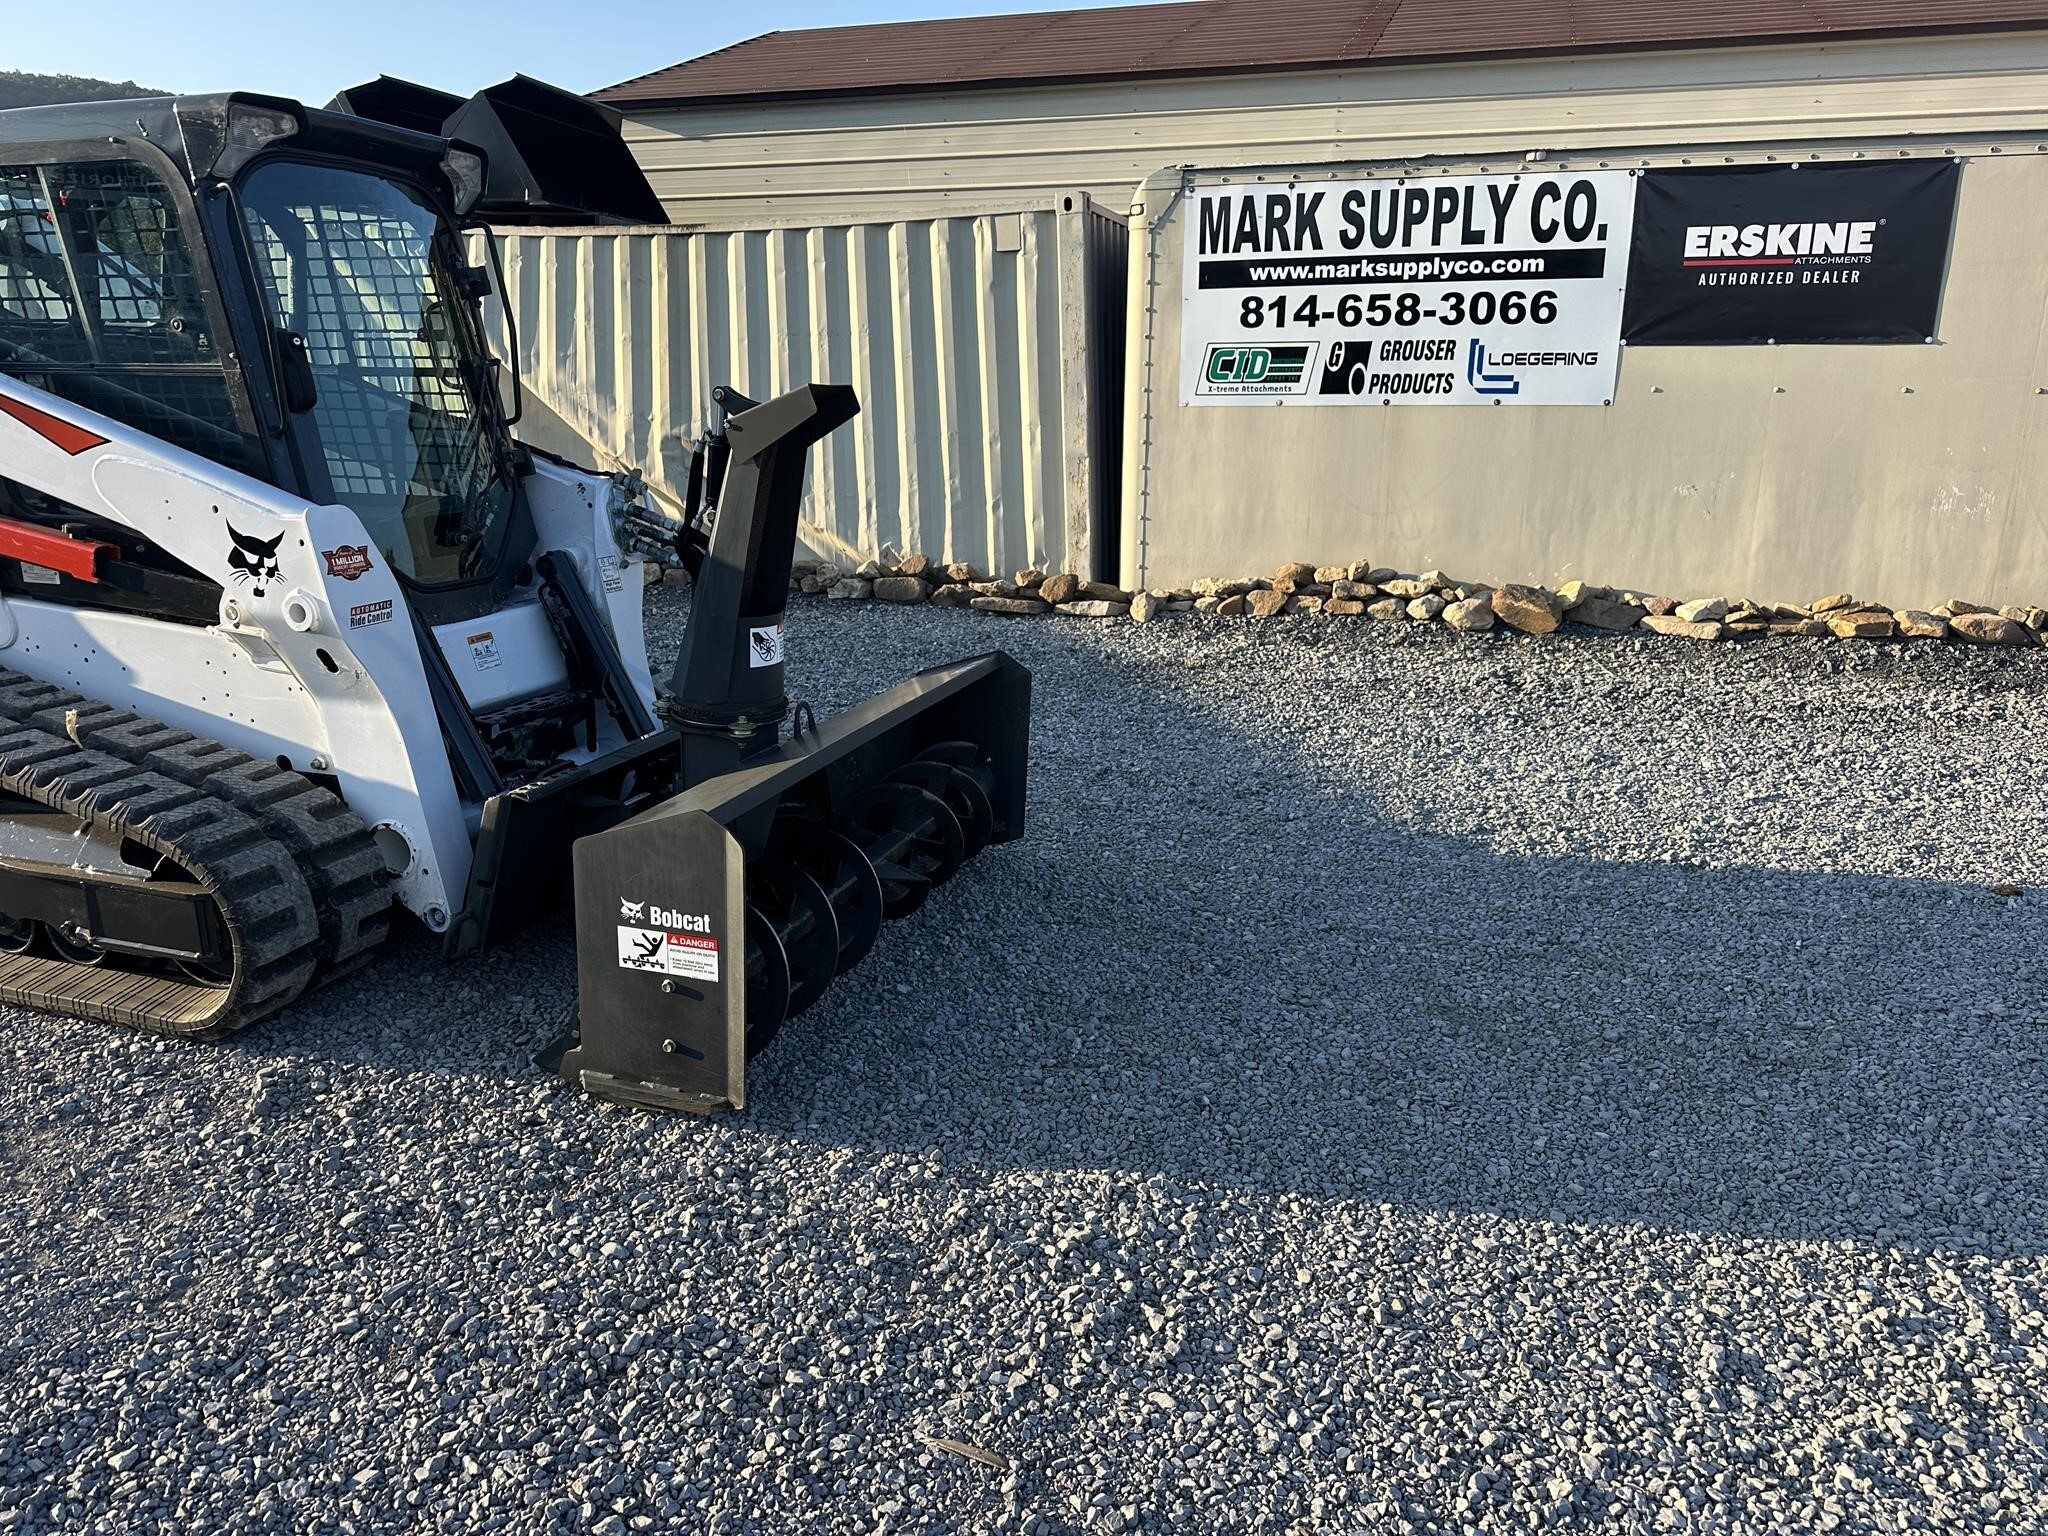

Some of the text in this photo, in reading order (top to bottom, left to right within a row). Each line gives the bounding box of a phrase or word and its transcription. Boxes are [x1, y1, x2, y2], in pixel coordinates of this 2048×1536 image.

[1199, 180, 1608, 255] MARK SUPPLY CO.
[1683, 222, 1876, 258] ERSKINE
[1250, 257, 1545, 281] www.marksupplyco.com
[1794, 255, 1872, 265] ATTACHMENTS
[1699, 270, 1860, 286] AUTHORIZED DEALER
[1239, 290, 1559, 328] 814-658-3066
[1379, 339, 1457, 362] GROUSER
[1488, 351, 1598, 366] LOEGERING
[1208, 348, 1272, 383] CID
[1207, 385, 1292, 393] X-treme Attachments
[1368, 372, 1454, 394] PRODUCTS
[336, 554, 365, 566] MILLION
[350, 609, 392, 628] Ride Control
[351, 601, 391, 616] AUTOMATIC
[649, 906, 711, 933] Bobcat
[679, 937, 715, 950] DANGER
